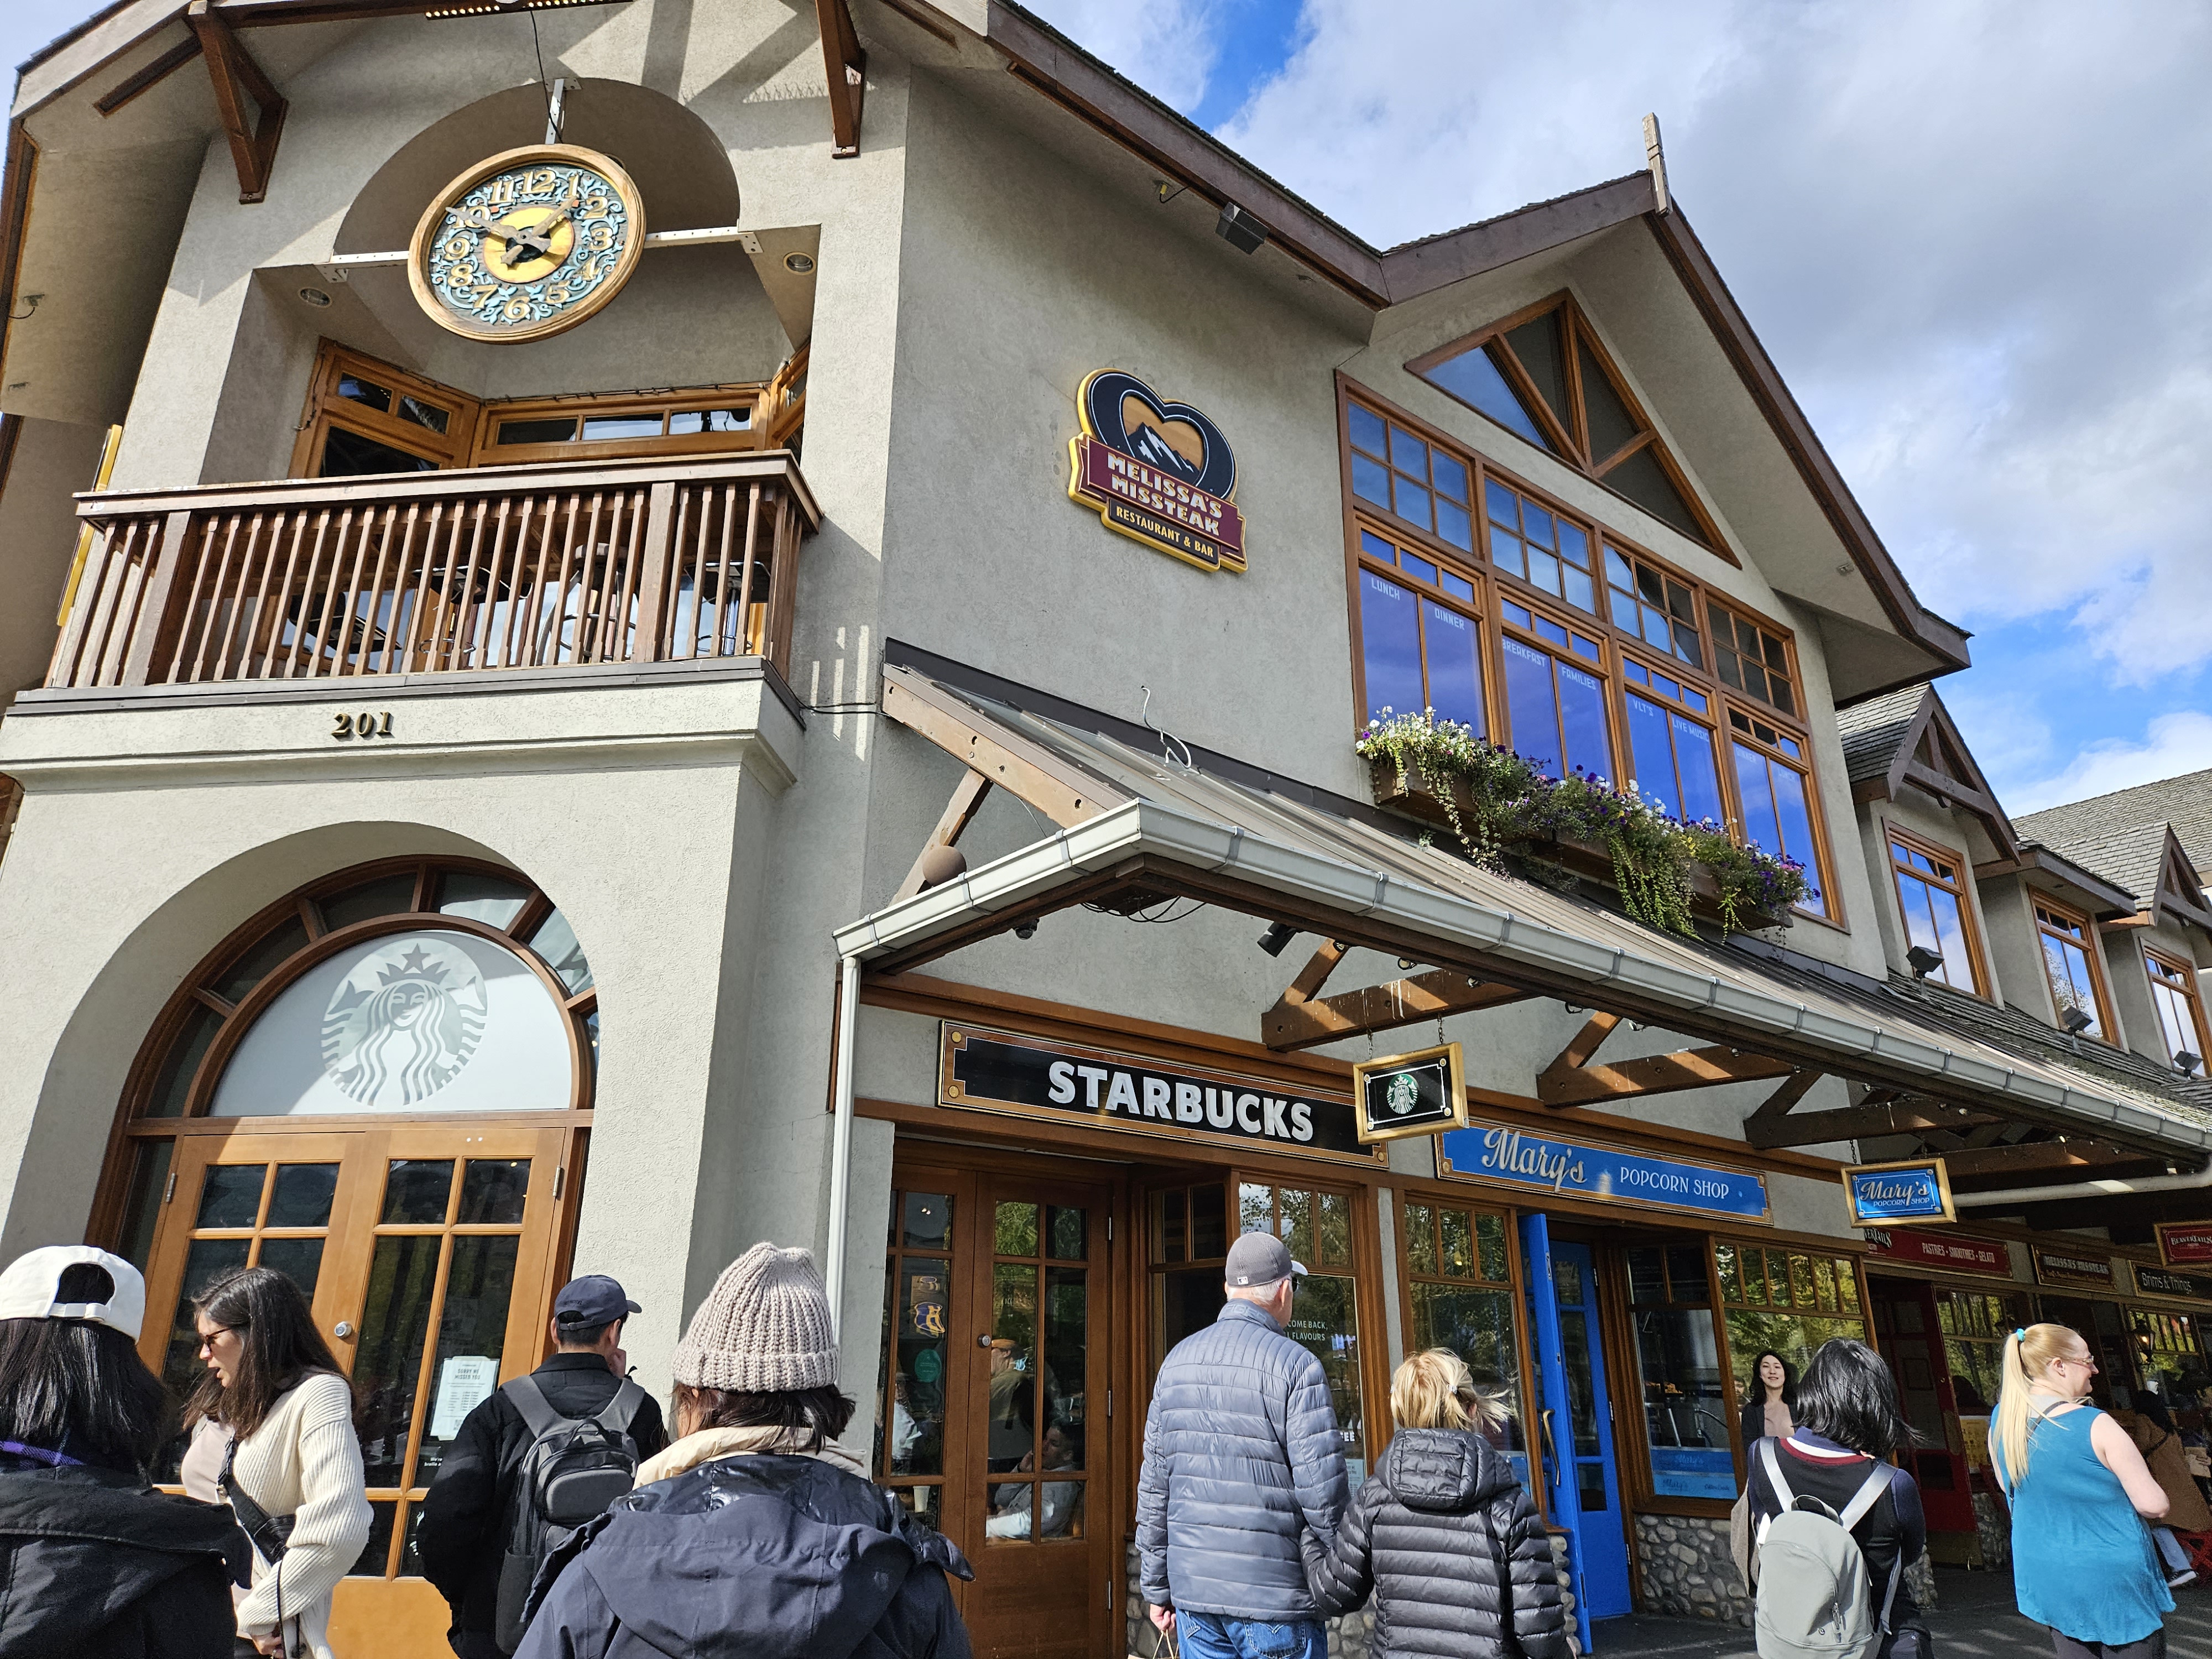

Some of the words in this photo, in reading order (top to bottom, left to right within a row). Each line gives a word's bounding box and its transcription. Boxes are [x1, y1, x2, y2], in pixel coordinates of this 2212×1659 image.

[488, 179, 516, 205] 11
[521, 169, 557, 195] 12
[565, 174, 581, 198] 1
[453, 205, 491, 229] 10
[583, 195, 609, 220] 2
[444, 237, 471, 261] 9
[591, 226, 615, 251] 3
[447, 263, 474, 288] 8
[575, 255, 599, 281] 4
[471, 284, 499, 309] 7
[545, 280, 570, 305] 5
[503, 296, 531, 320] 6
[1107, 452, 1223, 519] MELISSA'S
[1111, 473, 1220, 537] MISSTEAK
[1115, 505, 1181, 544] RESTAURANT
[1183, 535, 1192, 548] &
[1194, 540, 1214, 558] BAR
[1370, 577, 1401, 602] LUNCH
[1434, 607, 1465, 631] DINNER
[1502, 639, 1546, 667] BREAKFAST
[1561, 665, 1597, 691] FAMILIES
[1632, 698, 1654, 717] VLT'S
[330, 711, 393, 737] 201
[1672, 717, 1688, 733] LIVE
[1689, 724, 1710, 743] MUSIC
[1047, 1059, 1314, 1142] STARBUCKS
[1480, 1126, 1588, 1193] Mary's
[1619, 1166, 1689, 1194] POPCORN
[1693, 1178, 1730, 1200] SHOP
[1859, 1180, 1930, 1207] Mary's
[1873, 1199, 1906, 1207] POPCORN
[1922, 1242, 1946, 1256] PASTRIES
[1949, 1246, 1975, 1261] SMOOTHIES
[1978, 1251, 1995, 1264] GELATO
[2141, 1272, 2163, 1289] Brims
[2163, 1277, 2171, 1289] &
[2171, 1276, 2193, 1295] Things
[1292, 1332, 1326, 1342] FLAVOURS
[1308, 1321, 1328, 1331] BACK,
